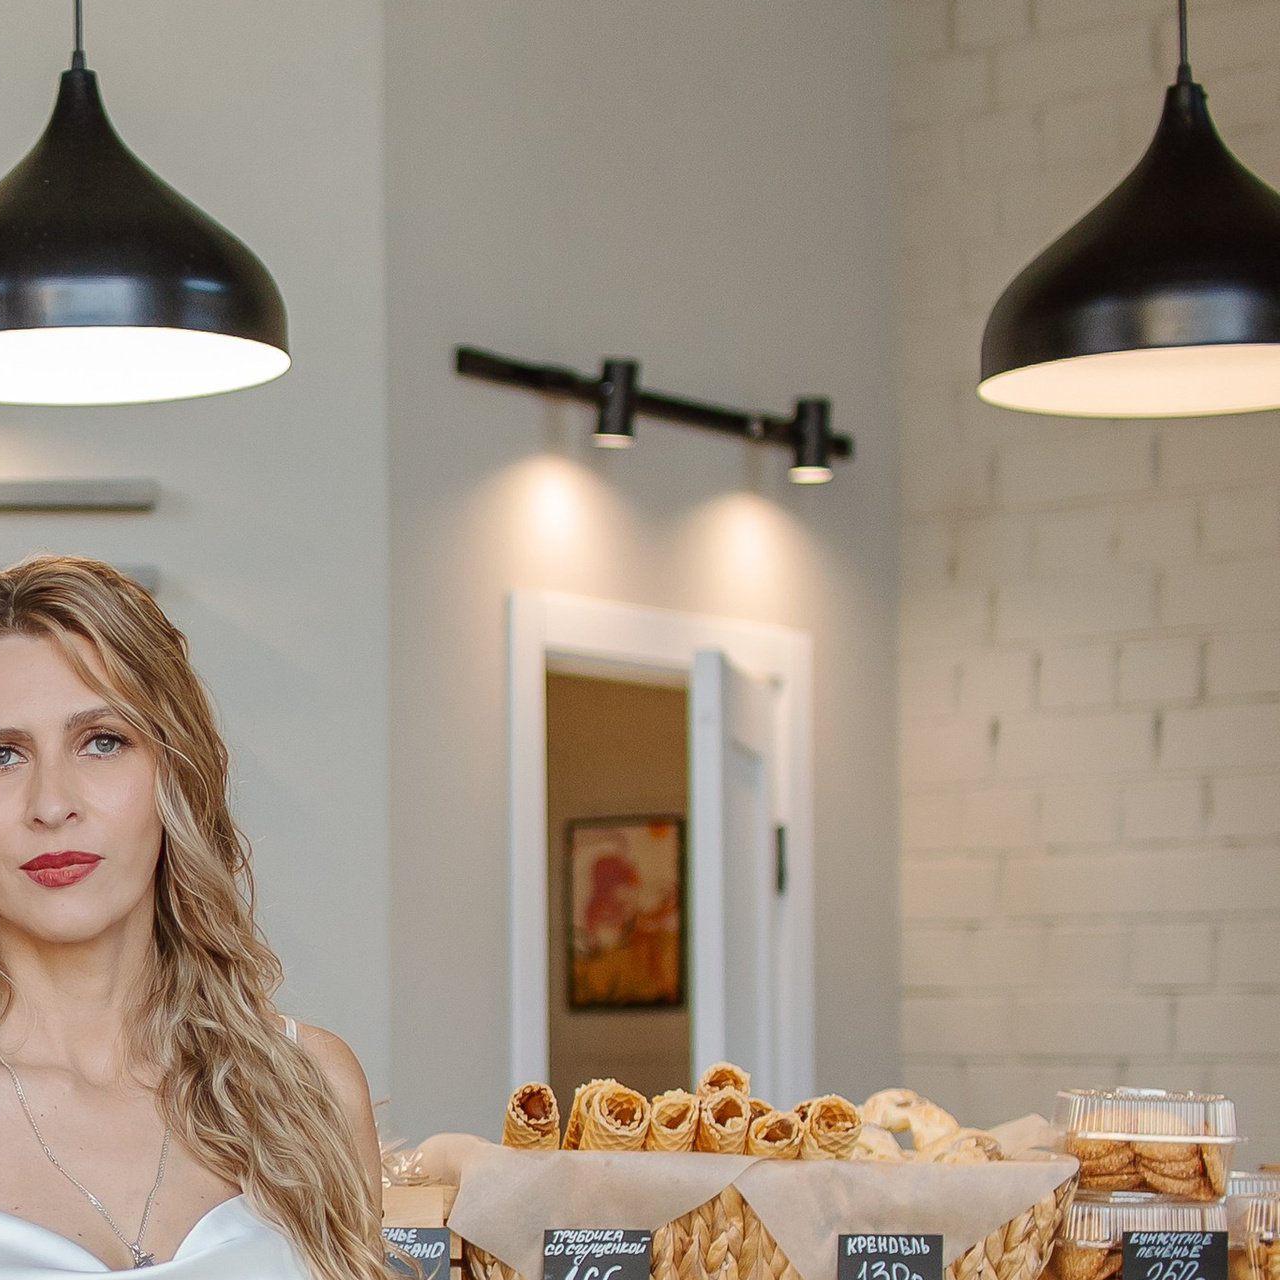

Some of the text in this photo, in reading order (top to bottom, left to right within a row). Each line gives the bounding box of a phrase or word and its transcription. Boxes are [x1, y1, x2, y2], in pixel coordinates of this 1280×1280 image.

[381, 1228, 418, 1243] ЕНЬЕ
[553, 1229, 624, 1244] ТРУБОЧКА
[1129, 1232, 1213, 1245] КУНЖУТНОЕ
[847, 1235, 930, 1256] КРЕНДЕЛЬ
